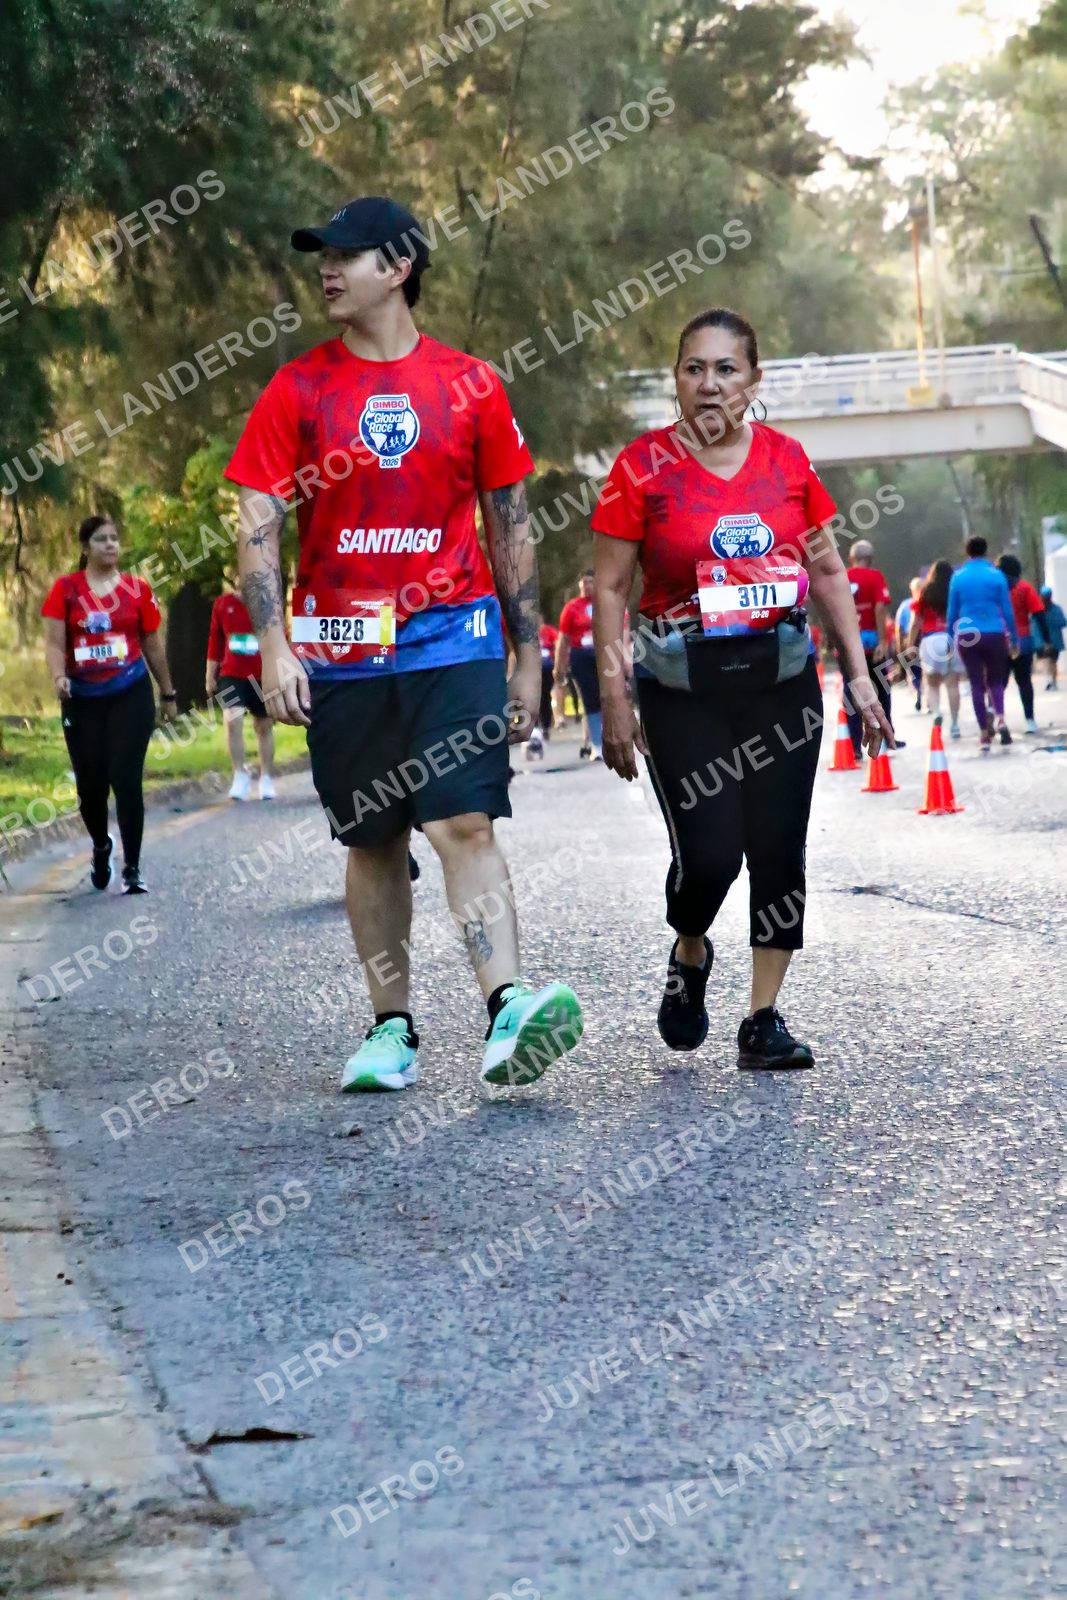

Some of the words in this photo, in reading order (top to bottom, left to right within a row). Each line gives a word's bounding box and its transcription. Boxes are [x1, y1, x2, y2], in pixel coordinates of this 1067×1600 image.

[373, 401, 404, 409] BIMBO
[373, 412, 404, 423] Global
[369, 422, 393, 433] Race
[382, 458, 399, 466] 2026
[726, 527, 757, 537] Global
[337, 528, 442, 554] SANTIAGO
[720, 535, 746, 545] Race
[738, 584, 777, 607] 3171
[464, 609, 487, 637] #11
[319, 618, 364, 641] 3628
[373, 656, 385, 664] 5K
